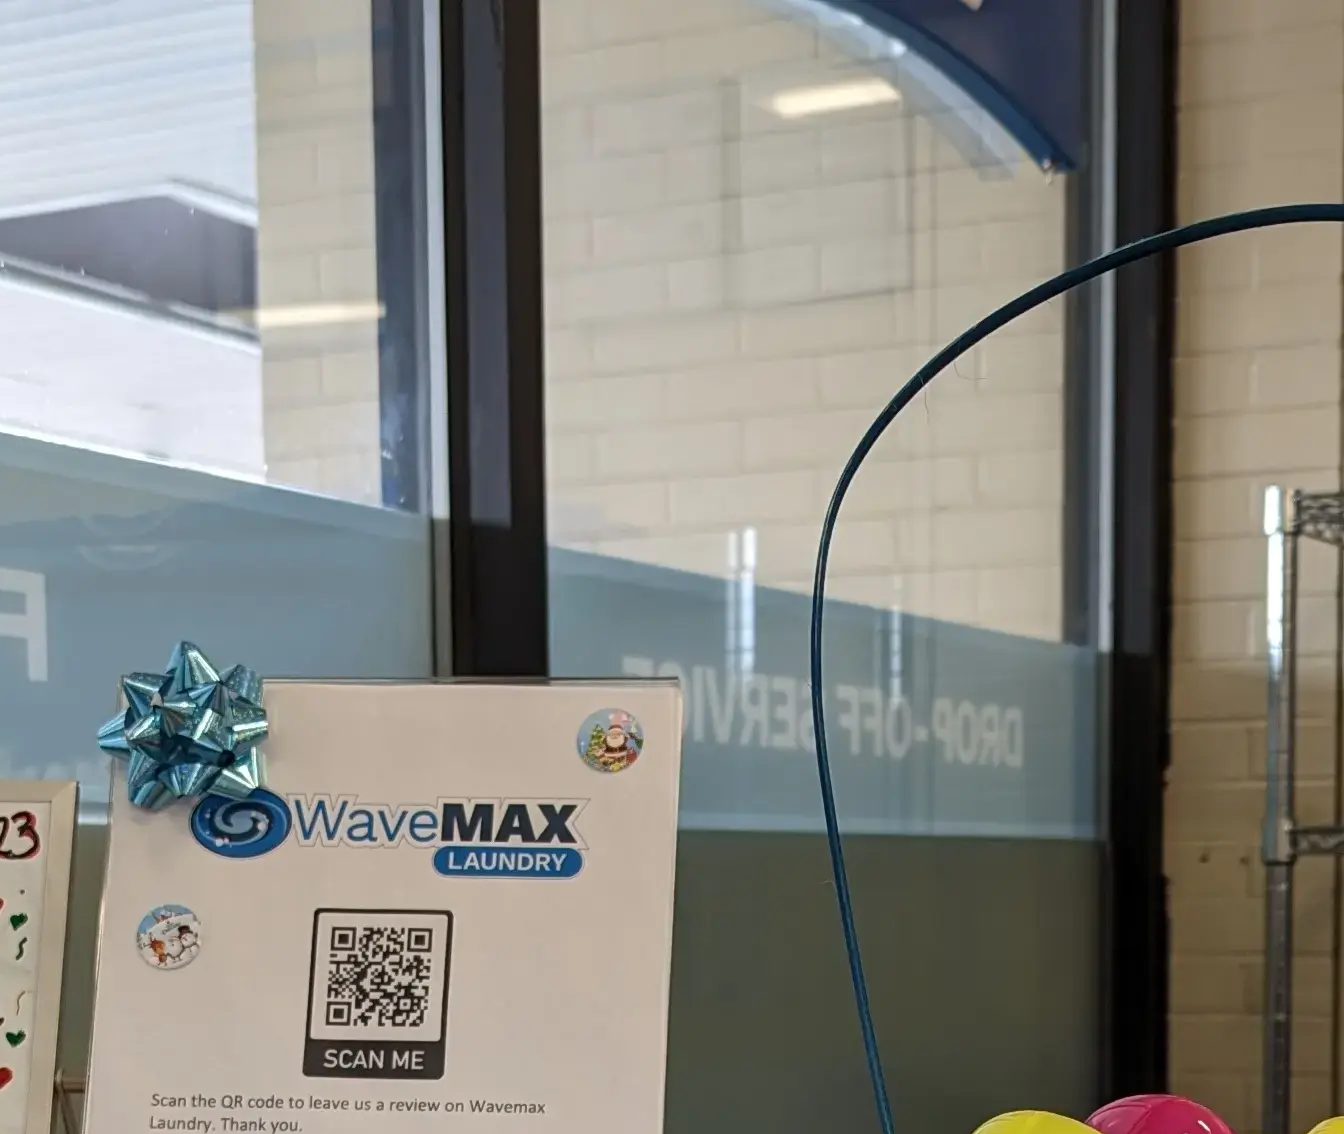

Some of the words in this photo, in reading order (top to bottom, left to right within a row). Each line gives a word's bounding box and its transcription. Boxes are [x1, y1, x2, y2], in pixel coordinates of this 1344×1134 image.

[293, 799, 578, 846] WaveMAX
[447, 850, 567, 873] LAUNDRY
[322, 1048, 385, 1071] SCAN
[390, 1048, 425, 1072] ME
[150, 1093, 188, 1108] Scan
[190, 1093, 217, 1109] the
[220, 1094, 244, 1110] QR
[247, 1095, 285, 1110] code
[288, 1096, 305, 1110] to
[308, 1095, 350, 1111] leave
[354, 1100, 372, 1112] us
[376, 1100, 385, 1112] a
[389, 1098, 441, 1113] review
[444, 1101, 465, 1113] on
[469, 1099, 546, 1115] Wavemax
[149, 1115, 216, 1134] Laundry.
[220, 1117, 267, 1132] Thank
[270, 1120, 304, 1134] you.
